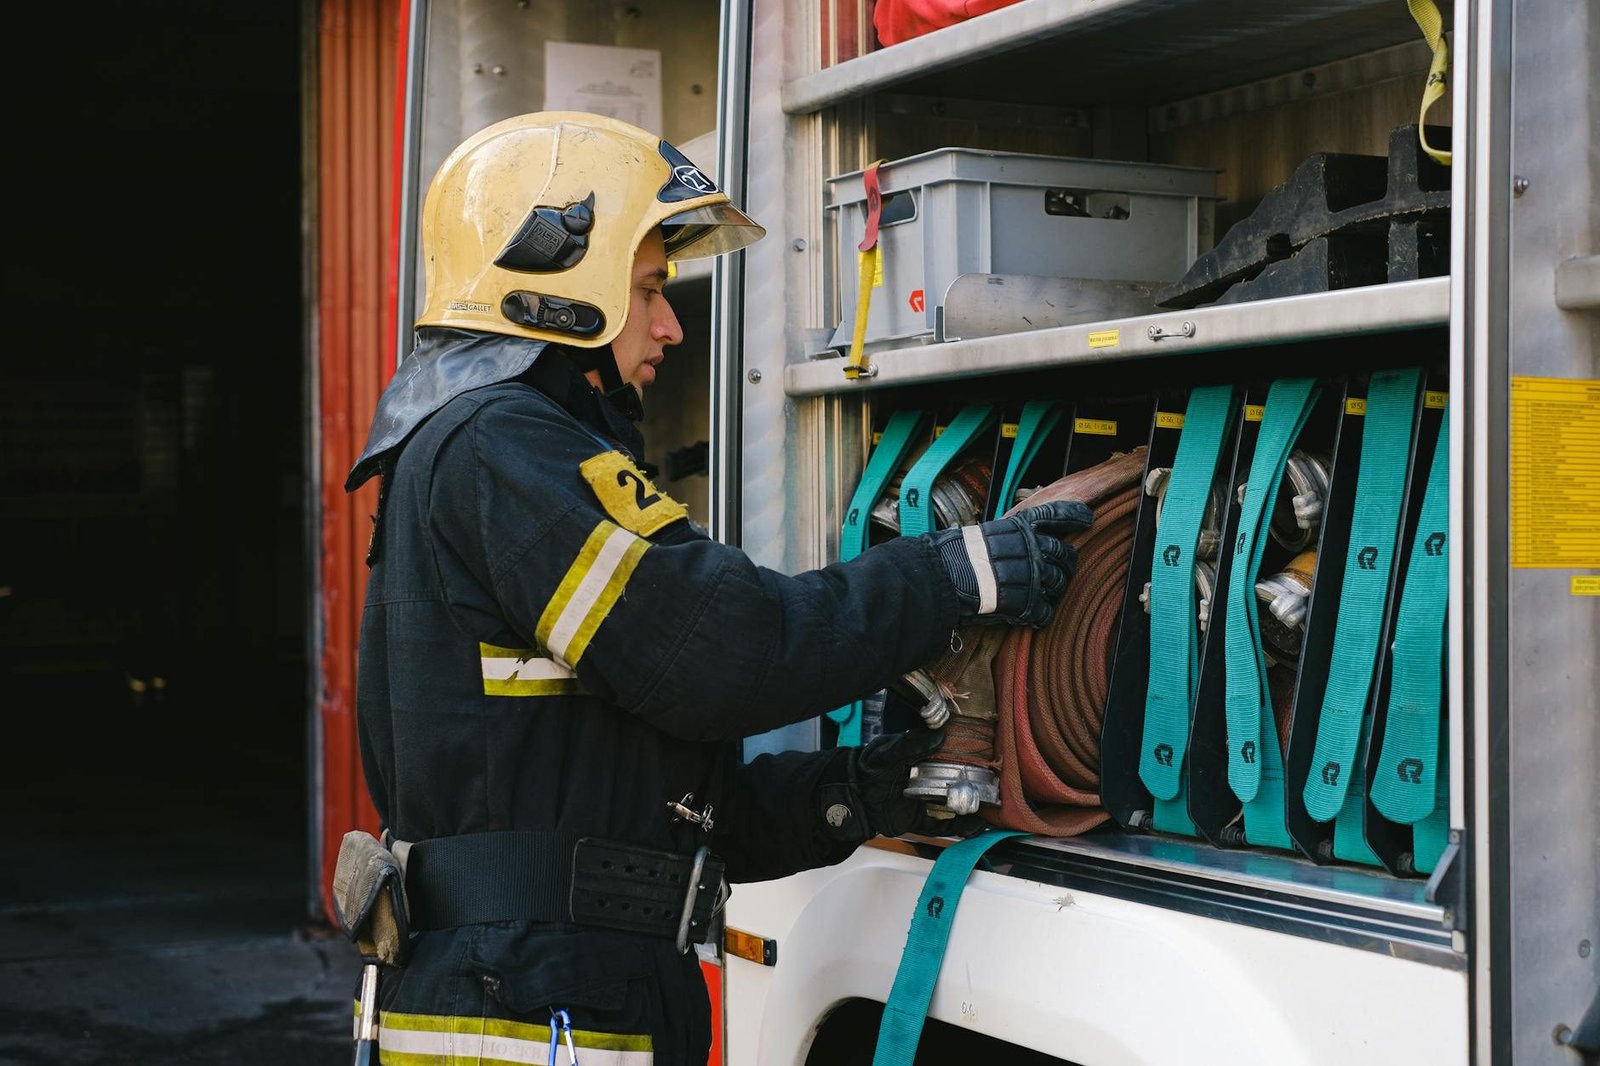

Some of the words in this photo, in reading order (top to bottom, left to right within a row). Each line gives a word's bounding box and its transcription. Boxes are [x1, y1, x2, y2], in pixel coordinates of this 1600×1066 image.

[681, 169, 711, 190] 27
[533, 223, 560, 248] MSA
[469, 304, 492, 312] GALLET
[617, 470, 662, 511] 2
